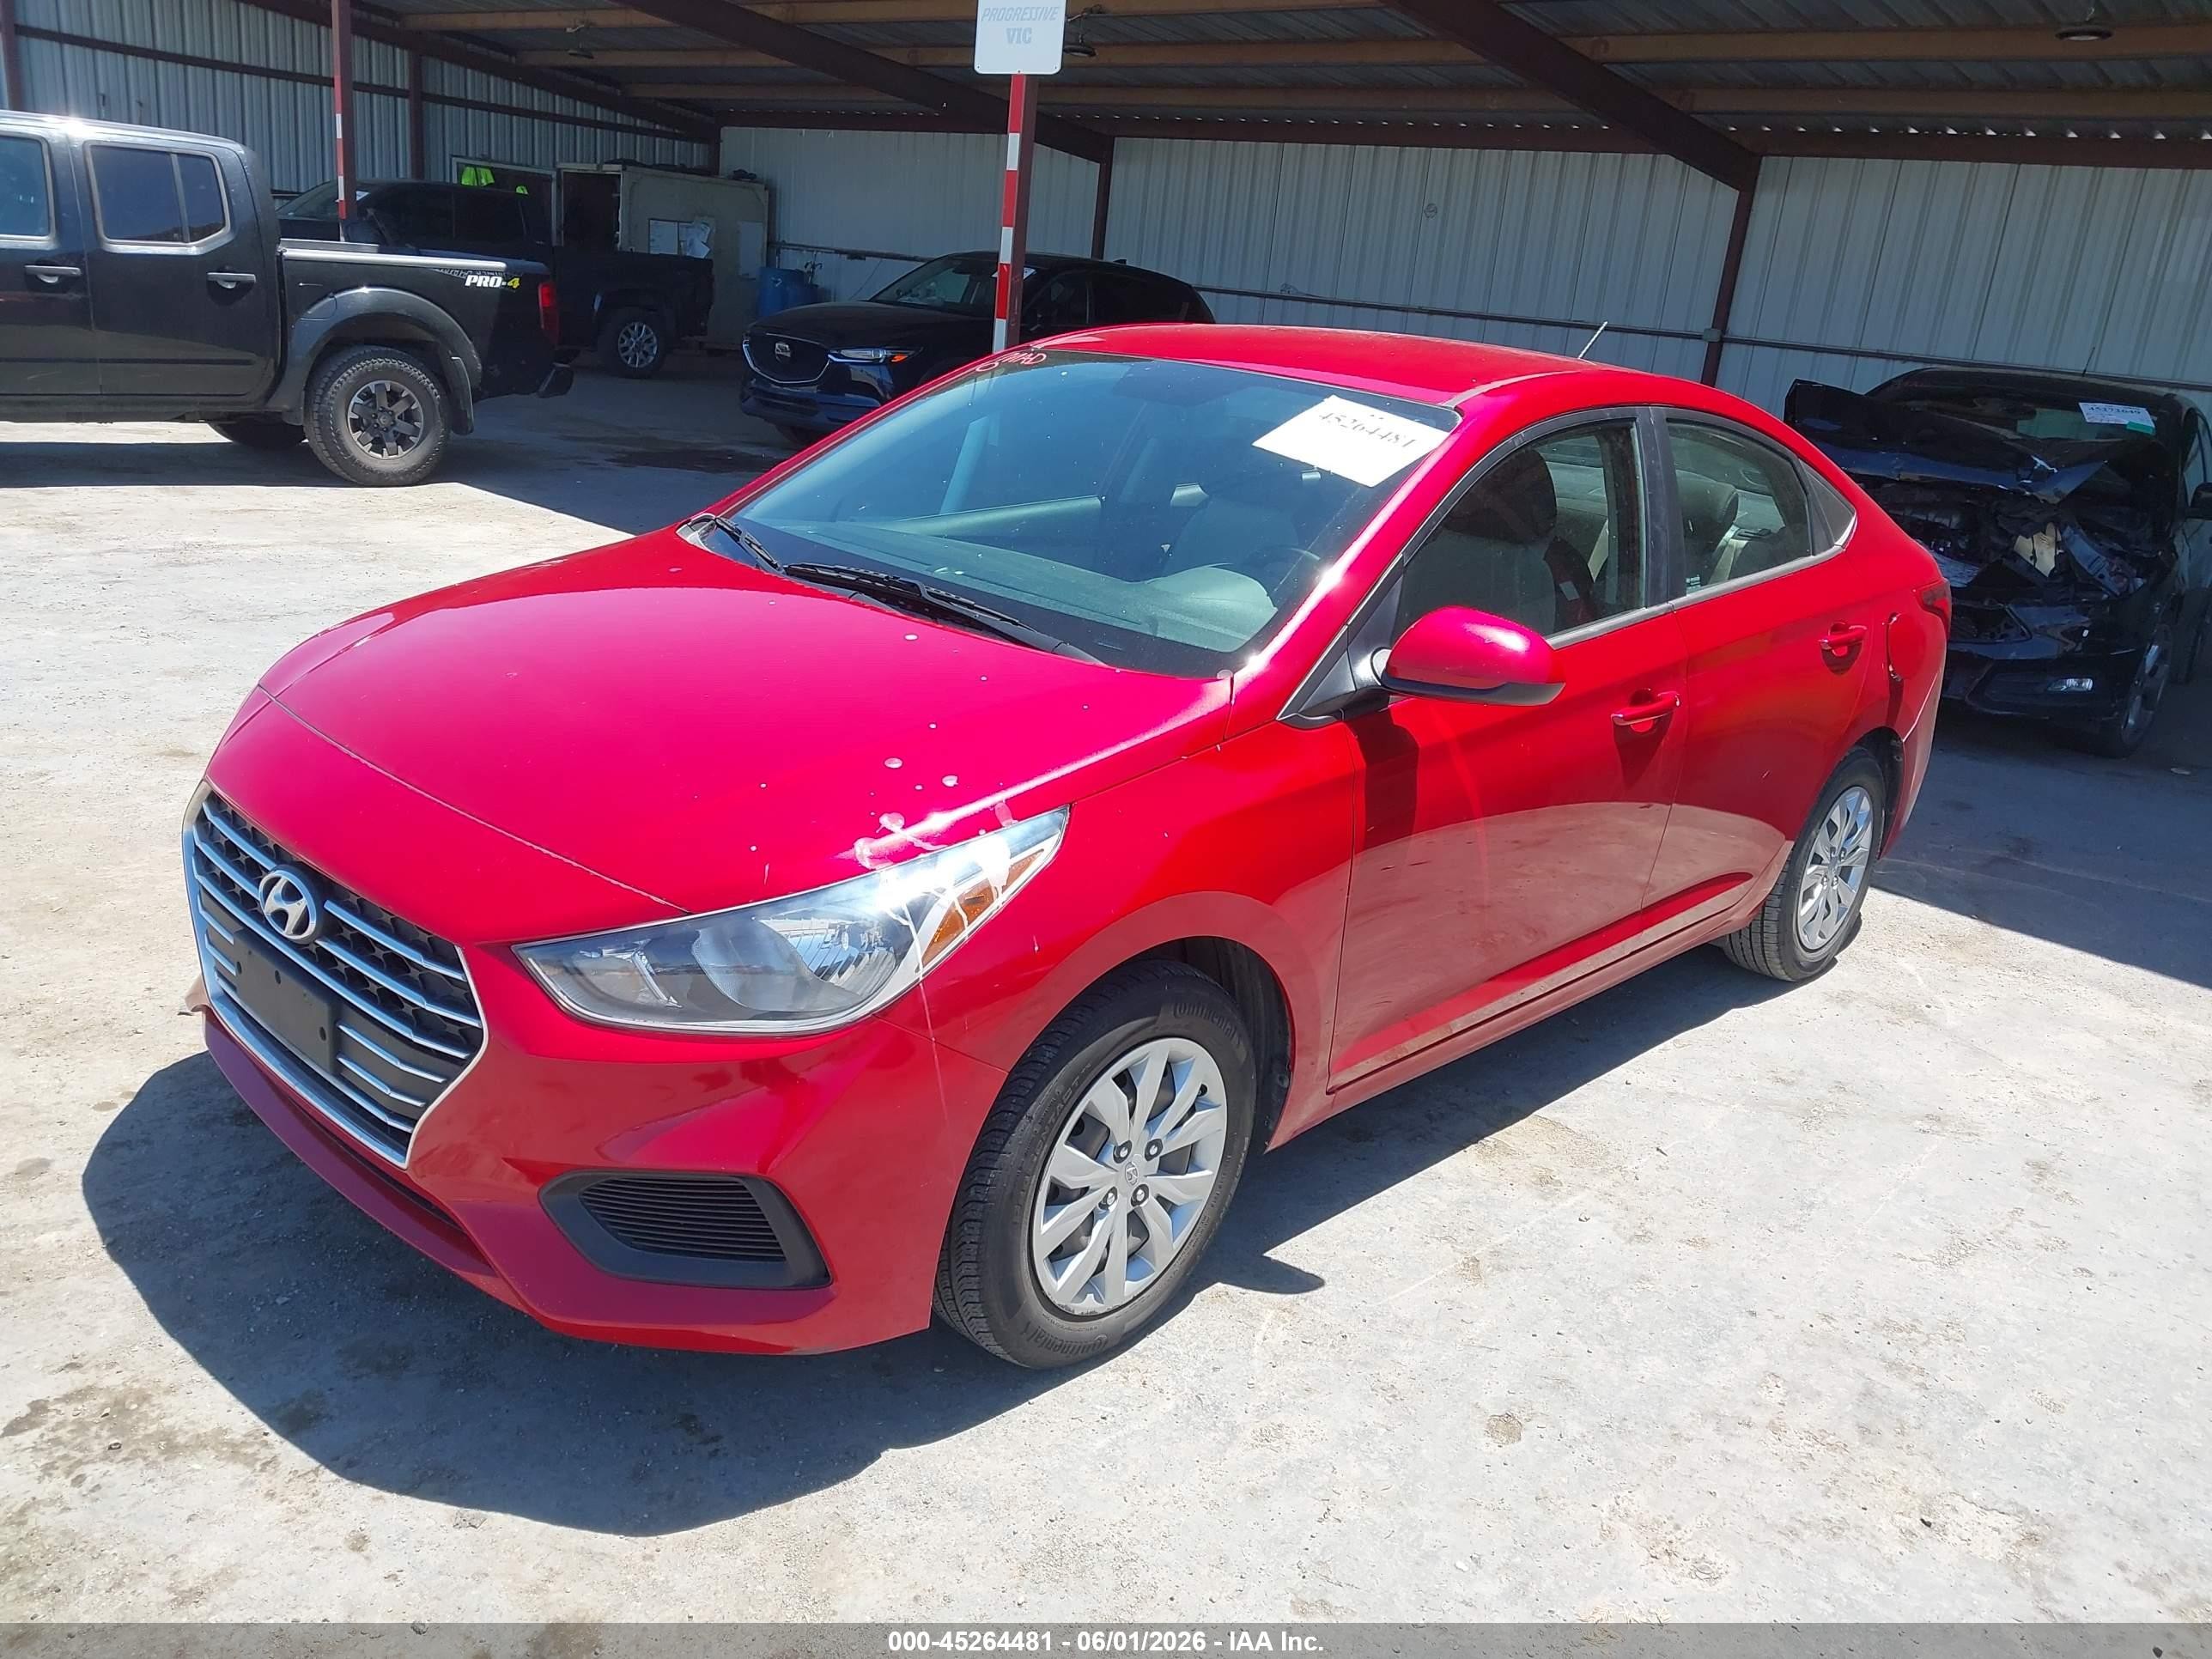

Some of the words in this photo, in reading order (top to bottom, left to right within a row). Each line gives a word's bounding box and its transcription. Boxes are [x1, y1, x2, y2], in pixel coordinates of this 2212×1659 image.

[981, 6, 1060, 21] PROGRESSIVE
[1006, 27, 1033, 45] VIC
[1028, 1326, 1108, 1355] Continental
